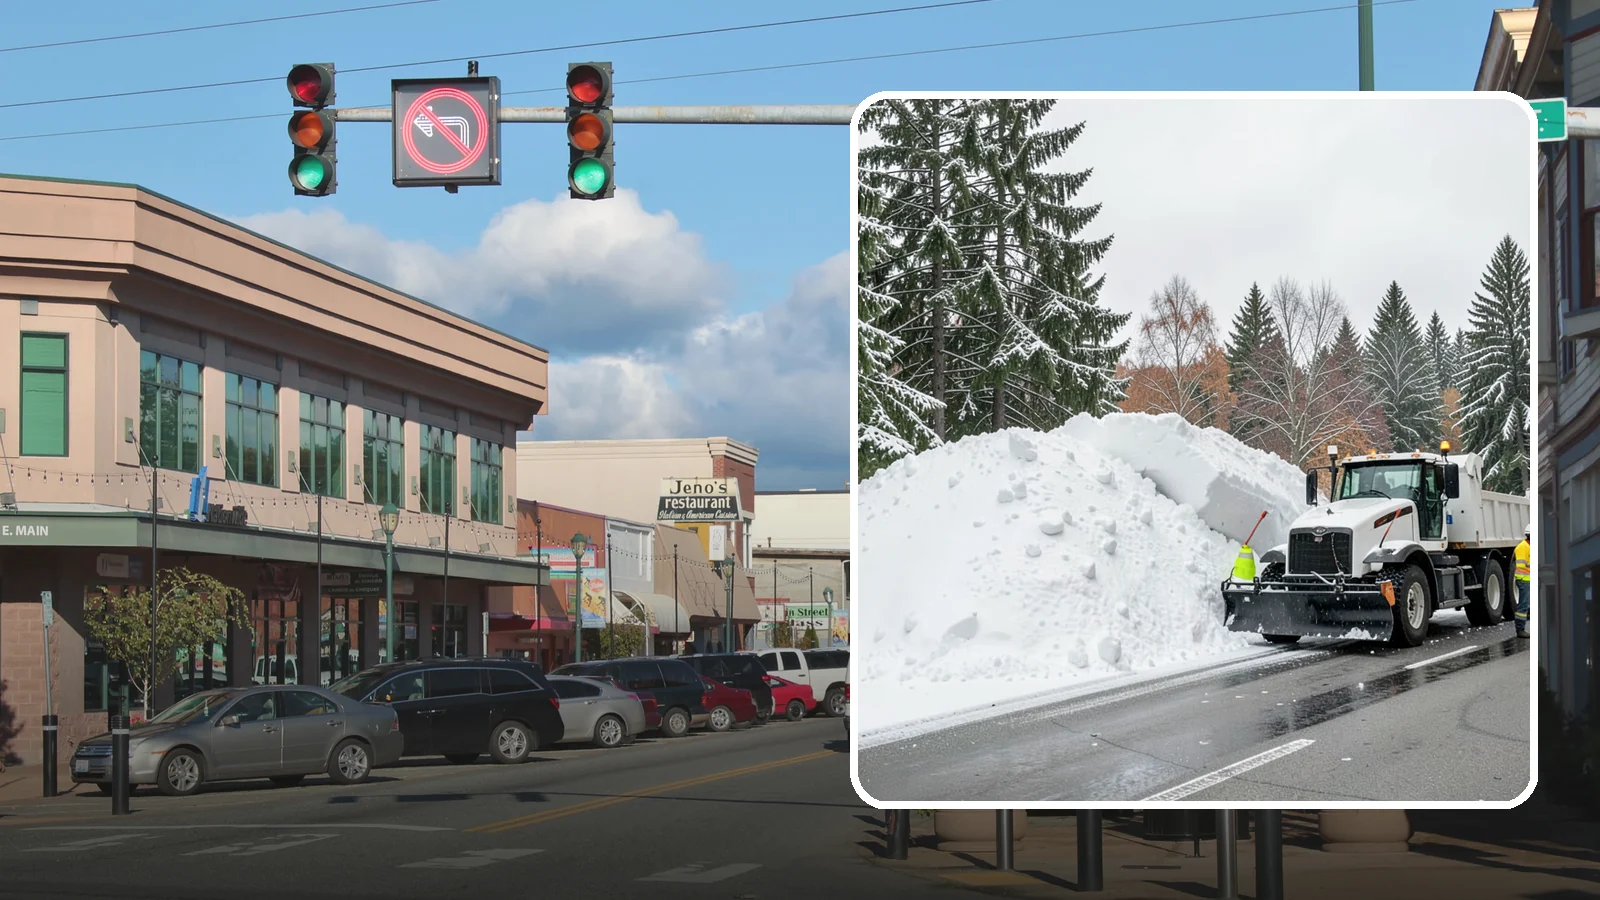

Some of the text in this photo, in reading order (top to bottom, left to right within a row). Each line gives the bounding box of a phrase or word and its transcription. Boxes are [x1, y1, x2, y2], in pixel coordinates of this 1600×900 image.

[670, 480, 727, 494] Jeno's
[665, 497, 731, 509] restaurant
[686, 510, 714, 519] American
[715, 510, 738, 519] Cuisine
[2, 525, 49, 536] E. MAIN
[797, 607, 828, 616] Street
